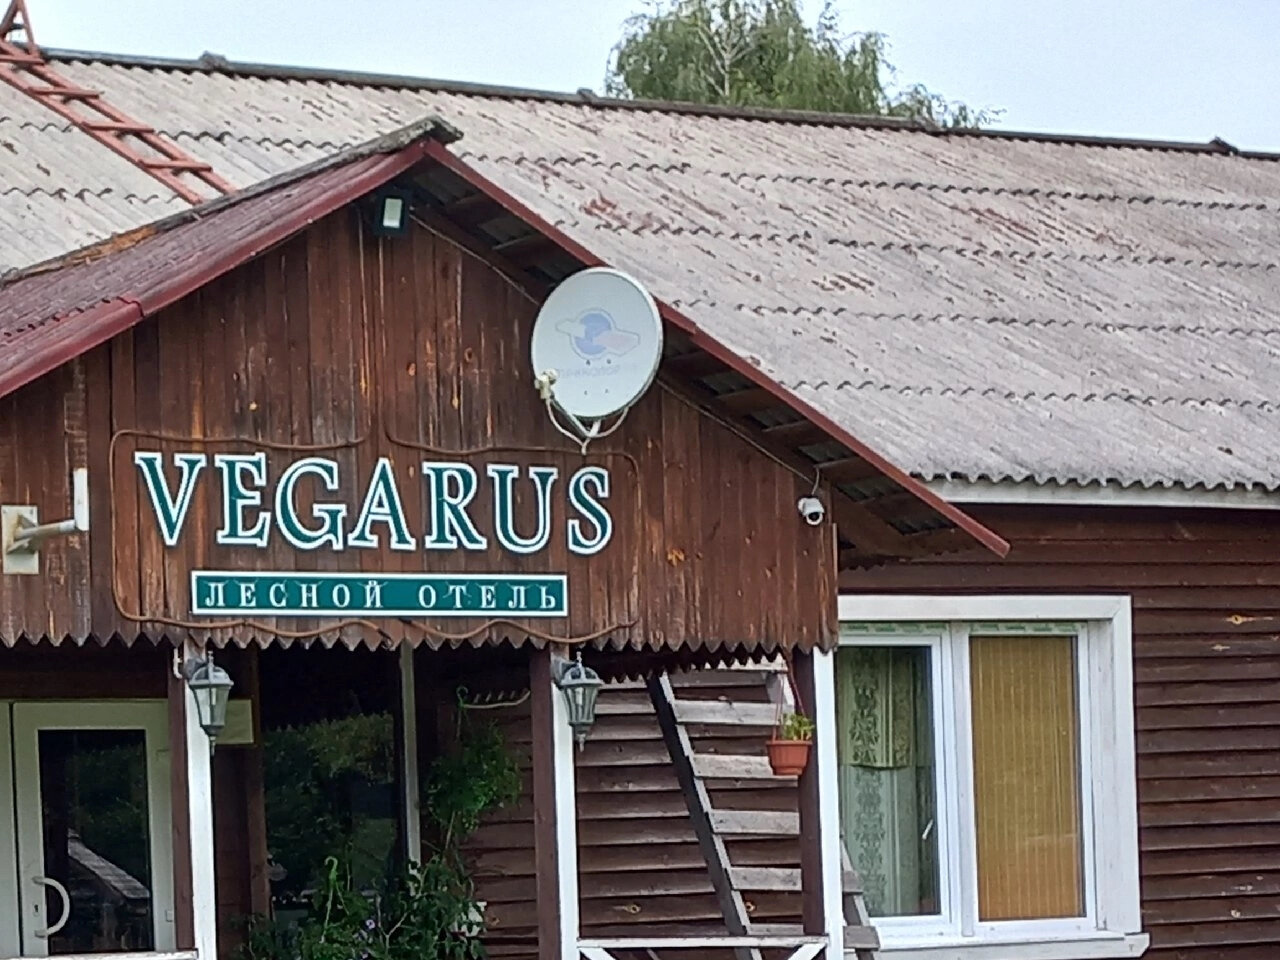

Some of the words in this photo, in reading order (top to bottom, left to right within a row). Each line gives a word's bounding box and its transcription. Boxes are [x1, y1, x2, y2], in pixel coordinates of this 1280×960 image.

[134, 451, 613, 555] VEGARUS
[204, 580, 384, 608] ЛЕСНОЙ
[417, 583, 557, 609] ОТЕЛЬ
